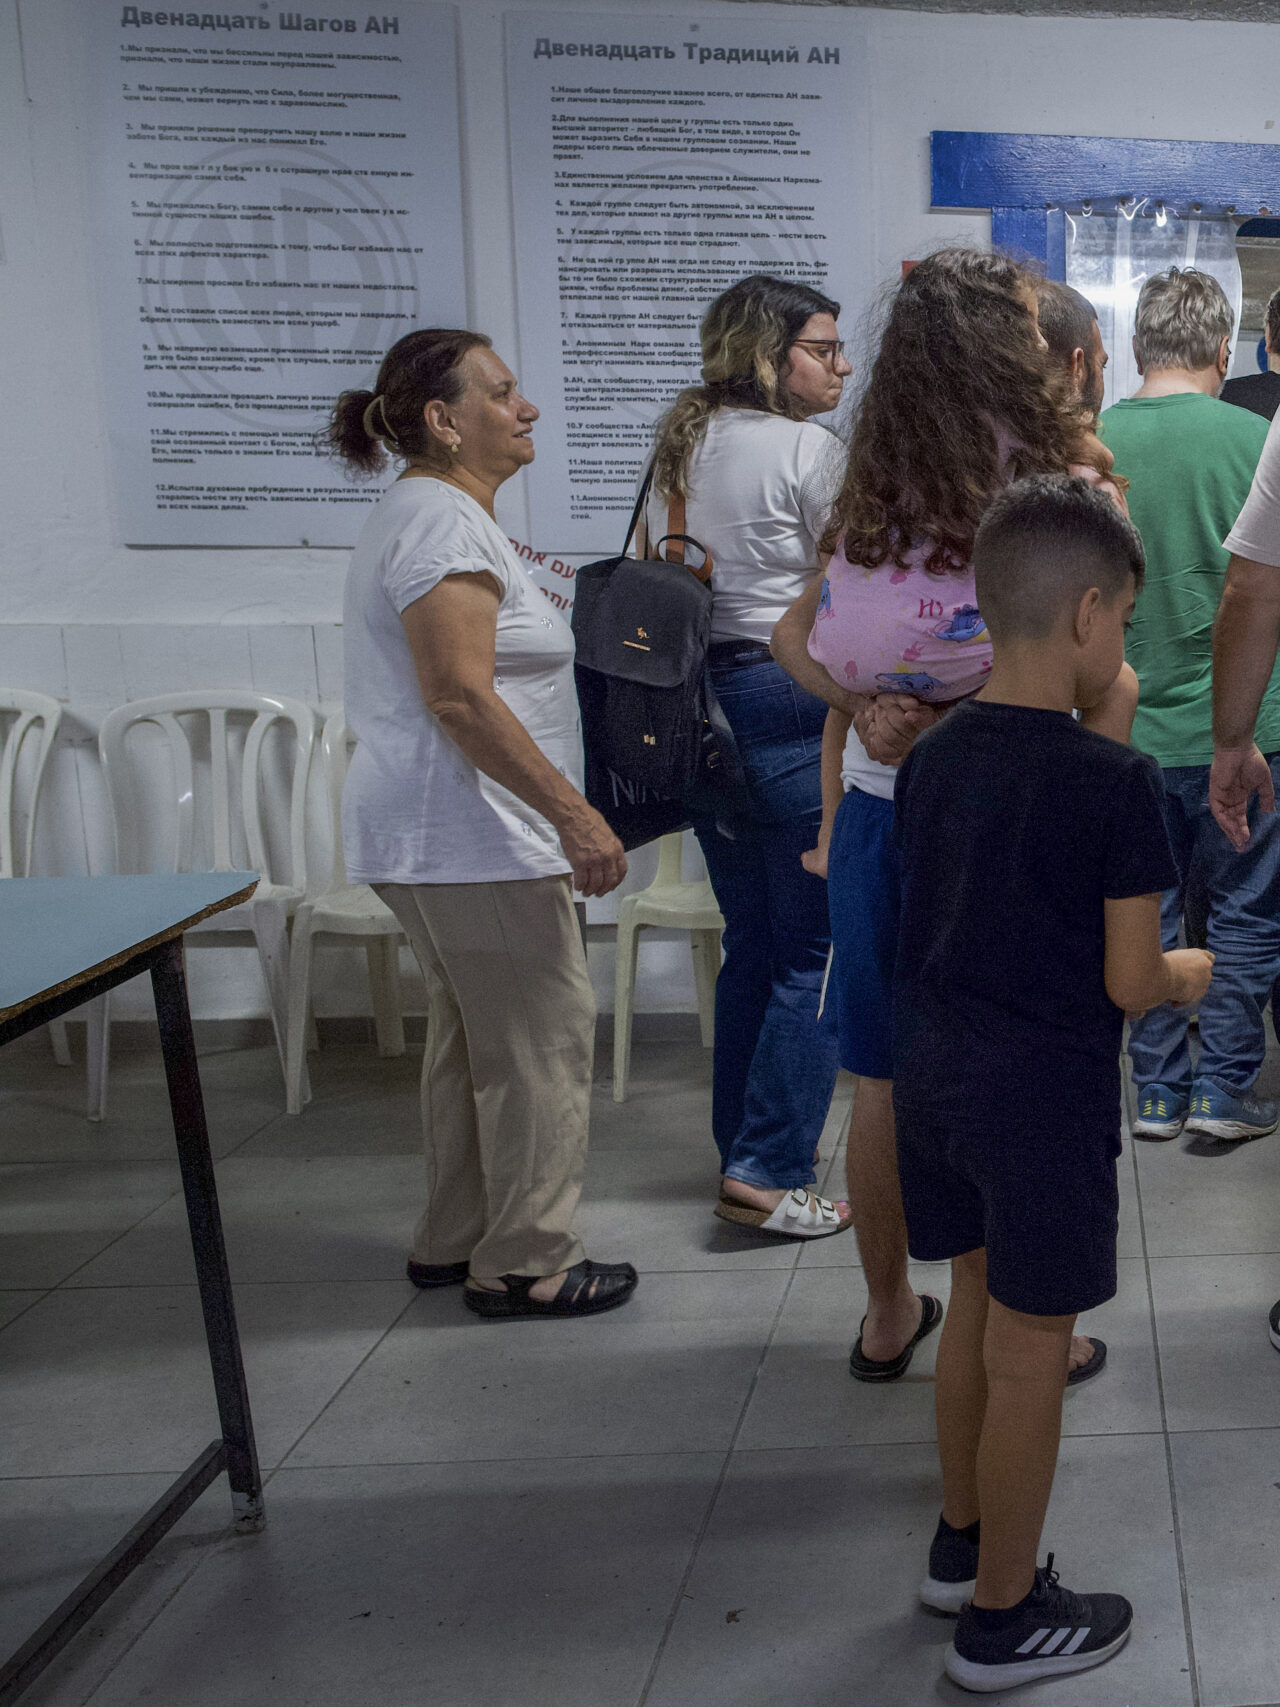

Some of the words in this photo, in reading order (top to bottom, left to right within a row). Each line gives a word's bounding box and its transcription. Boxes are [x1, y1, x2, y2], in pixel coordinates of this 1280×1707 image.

[120, 6, 270, 31] Двенадцать
[279, 12, 356, 32] Шагов
[364, 15, 399, 34] АН
[533, 38, 675, 61] Двенадцать
[683, 42, 799, 65] Традиций
[806, 46, 839, 64] АН
